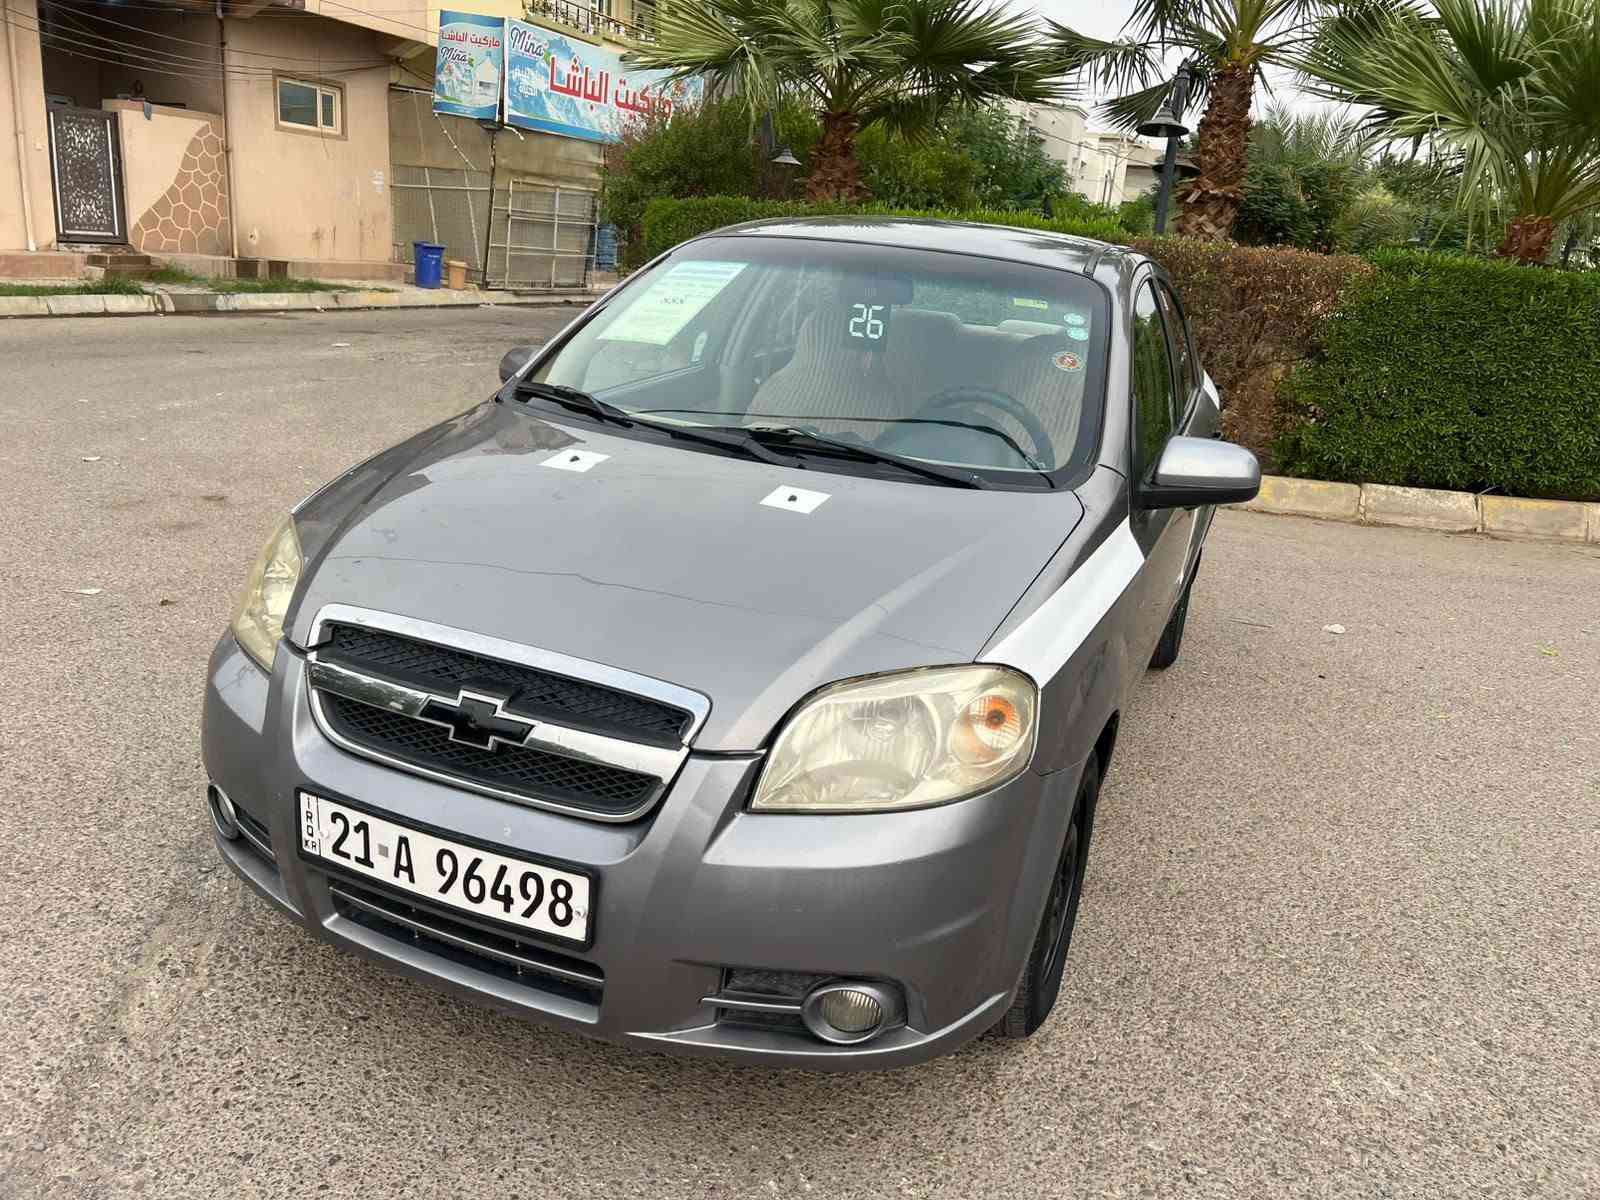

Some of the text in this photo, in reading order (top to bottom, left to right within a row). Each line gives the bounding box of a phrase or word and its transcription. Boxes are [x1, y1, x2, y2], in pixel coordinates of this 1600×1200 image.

[440, 46, 467, 62] Mina
[441, 31, 501, 48] ماركيت الباشا
[510, 26, 544, 57] Mina
[550, 56, 609, 111] الباشا
[849, 303, 885, 339] 26
[330, 811, 574, 928] 21 A 96498
